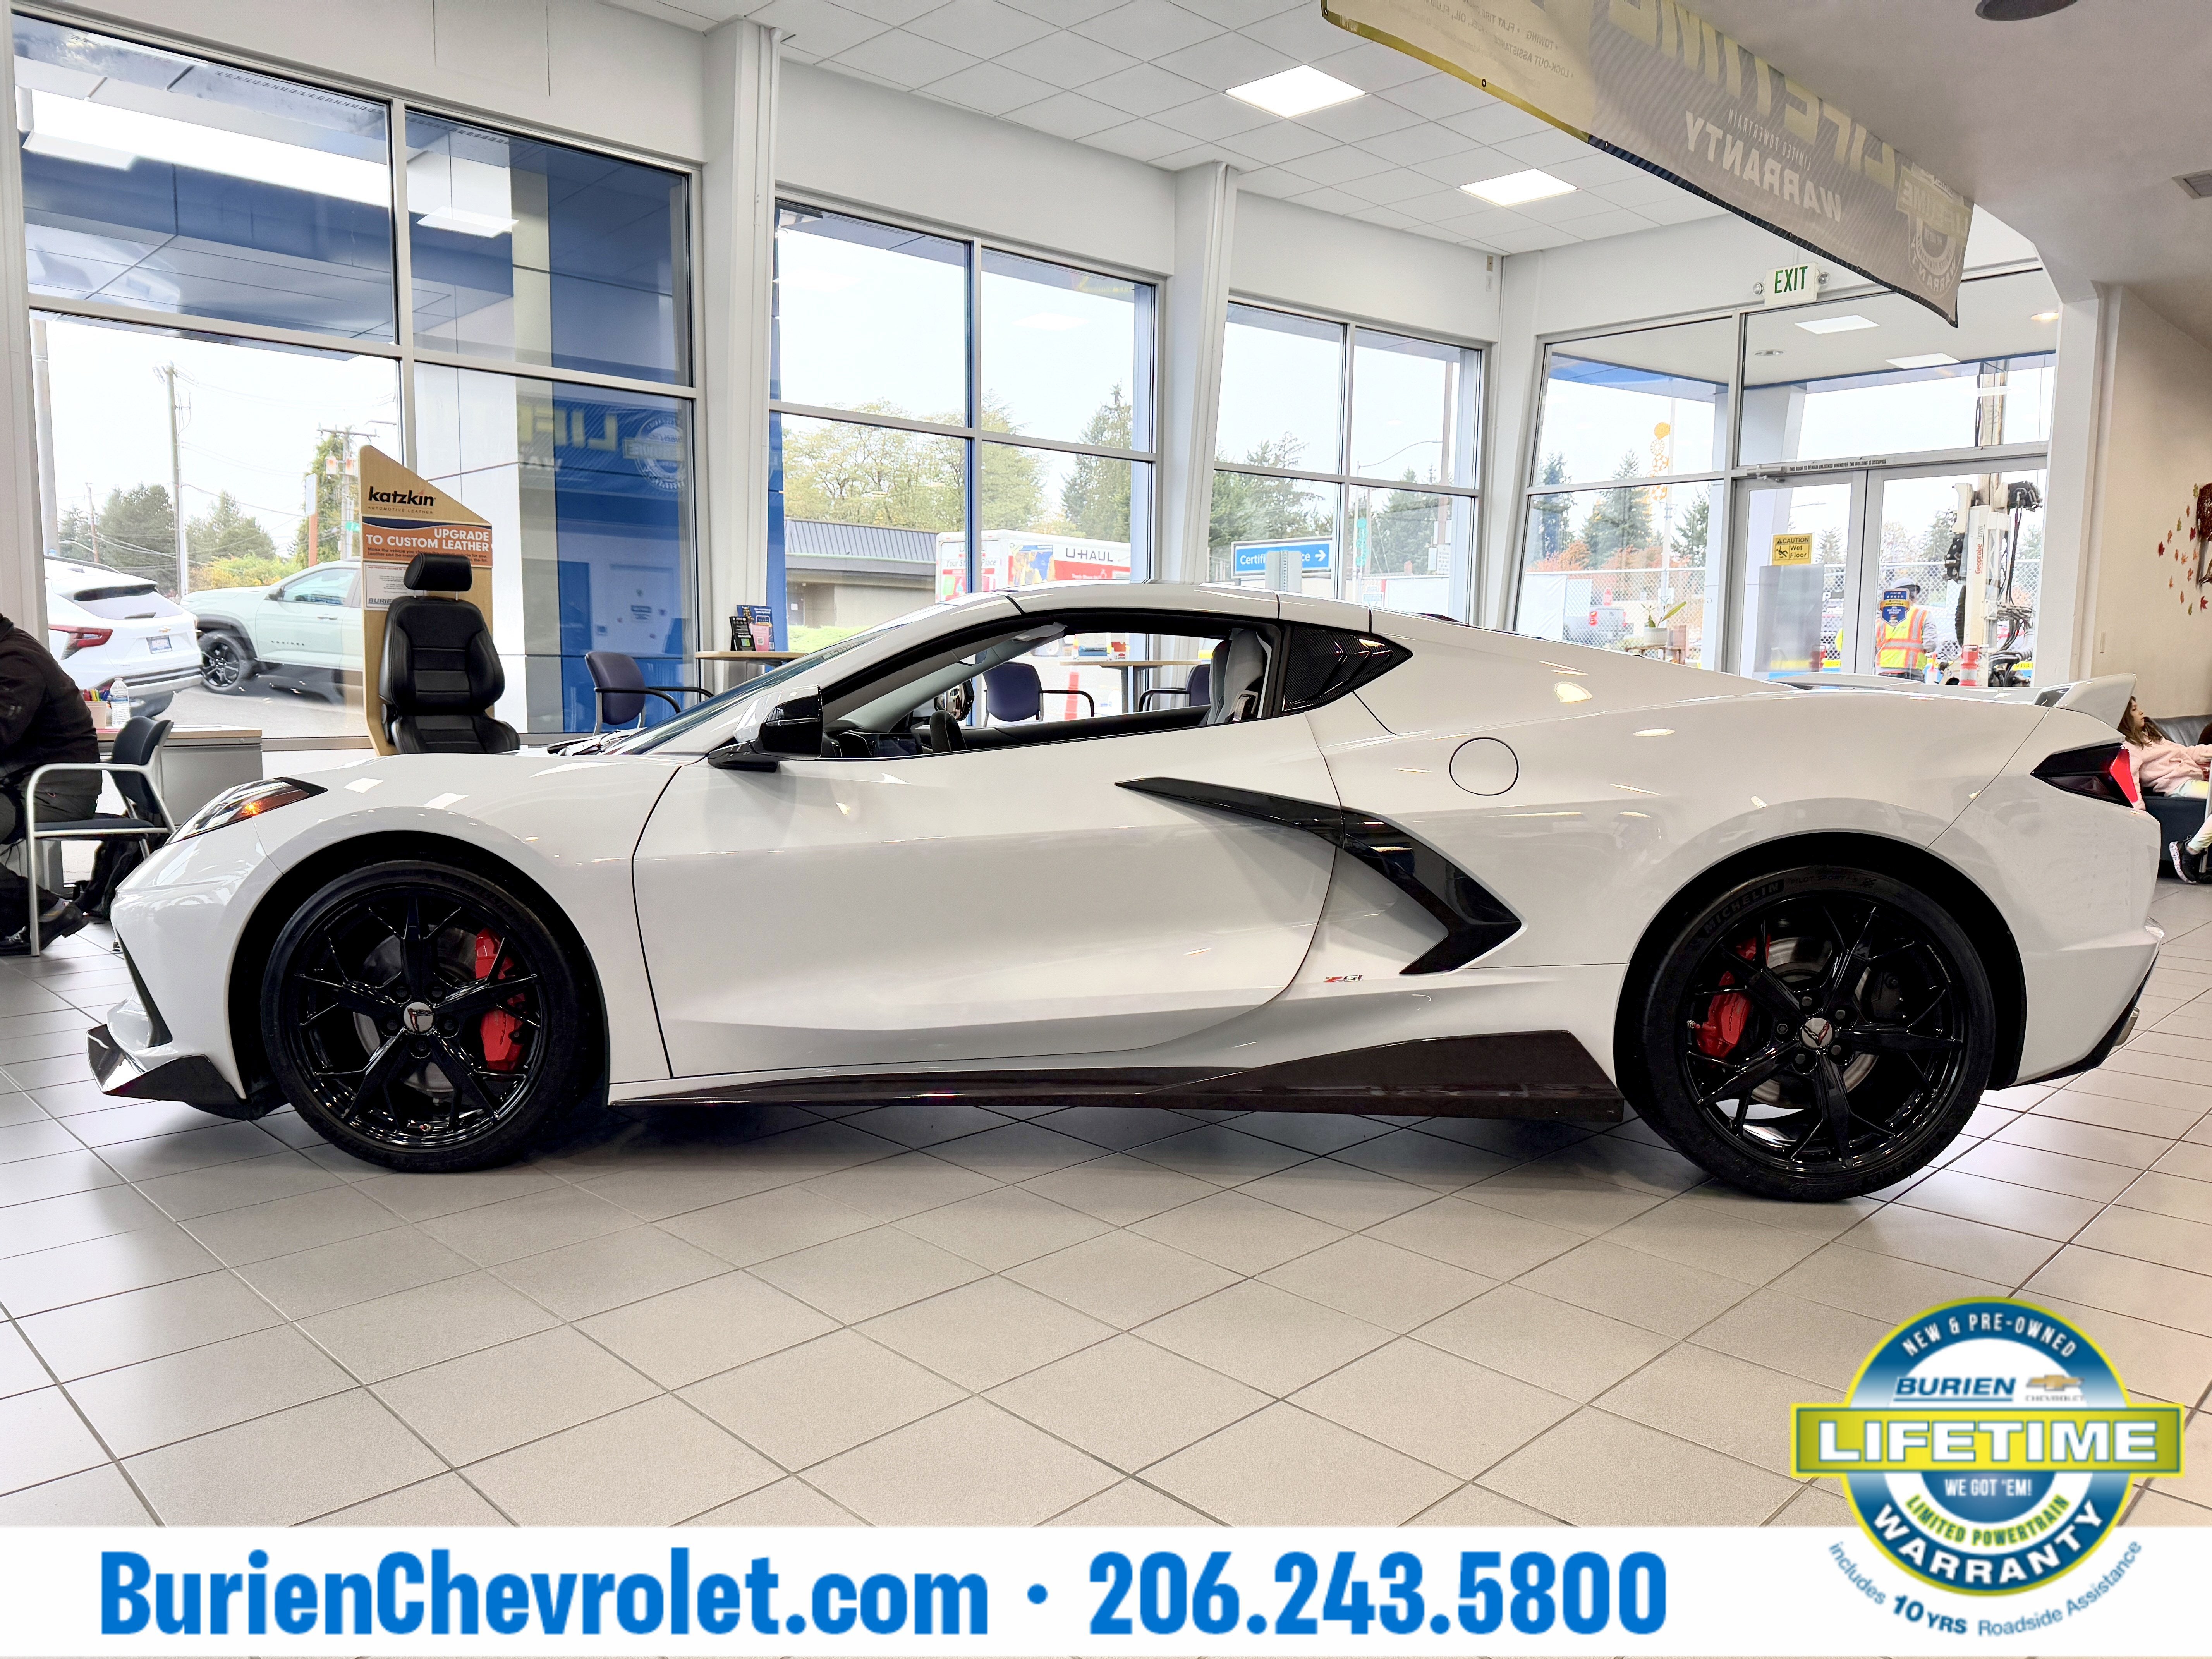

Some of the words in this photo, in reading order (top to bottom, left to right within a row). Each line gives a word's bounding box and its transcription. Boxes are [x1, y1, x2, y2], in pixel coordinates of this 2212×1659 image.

[1774, 266, 1808, 293] EXIT
[368, 486, 434, 507] katzkin
[366, 534, 383, 545] TO
[387, 536, 438, 548] CUSTOM
[442, 539, 489, 552] LEATHER
[434, 528, 489, 541] UPGRADE
[1066, 547, 1113, 562] U-HAUL
[1240, 555, 1266, 565] Certifi
[1704, 882, 1779, 934] MICHELIN
